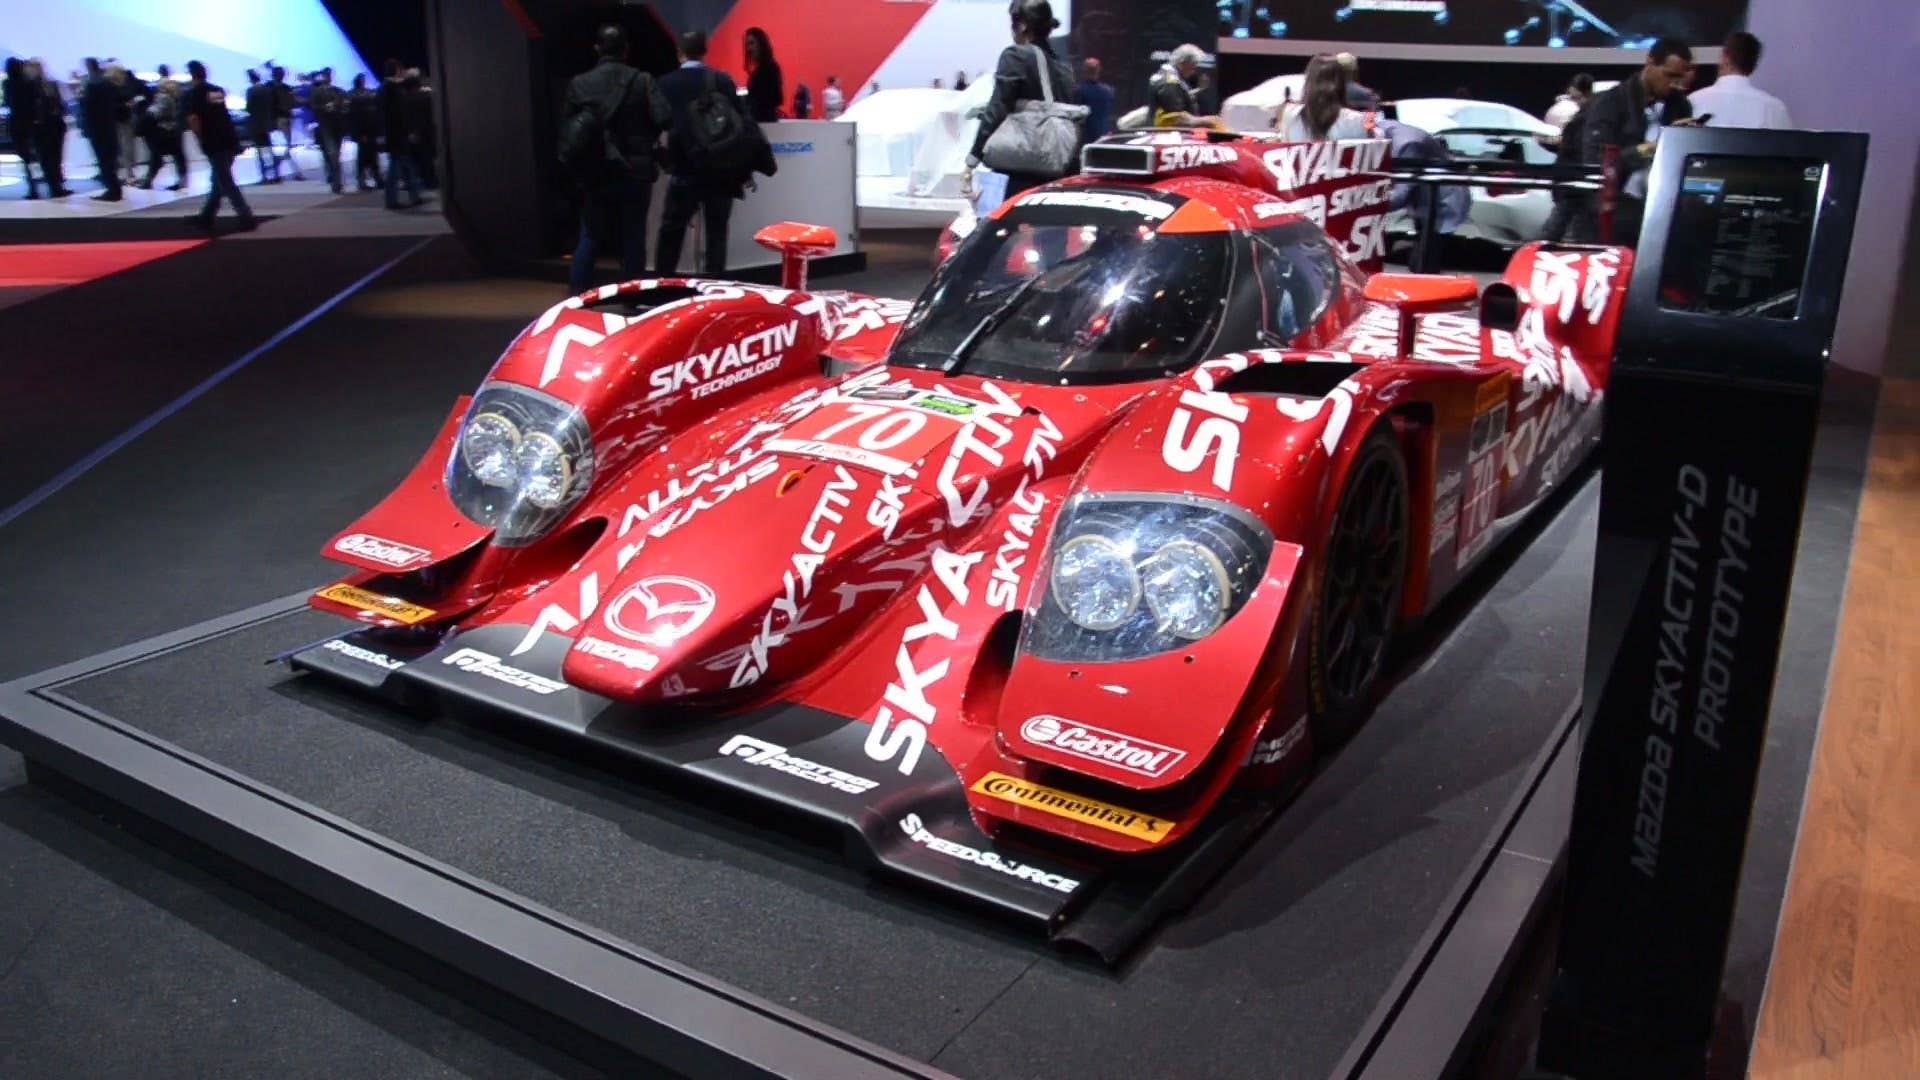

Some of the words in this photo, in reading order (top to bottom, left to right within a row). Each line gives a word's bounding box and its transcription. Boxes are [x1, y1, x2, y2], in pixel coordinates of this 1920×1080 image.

[648, 320, 798, 401] SKYACTIV
[691, 354, 783, 400] TECHNOLOGY
[812, 404, 928, 450] 70
[985, 414, 1063, 612] SKYACTIV
[729, 465, 858, 689] SKYACTIV
[1650, 463, 1708, 735] SKYACTIV-D
[1693, 474, 1758, 751] PROTOTYPE
[1056, 726, 1167, 772] Castrol
[984, 777, 1138, 828] Continental
